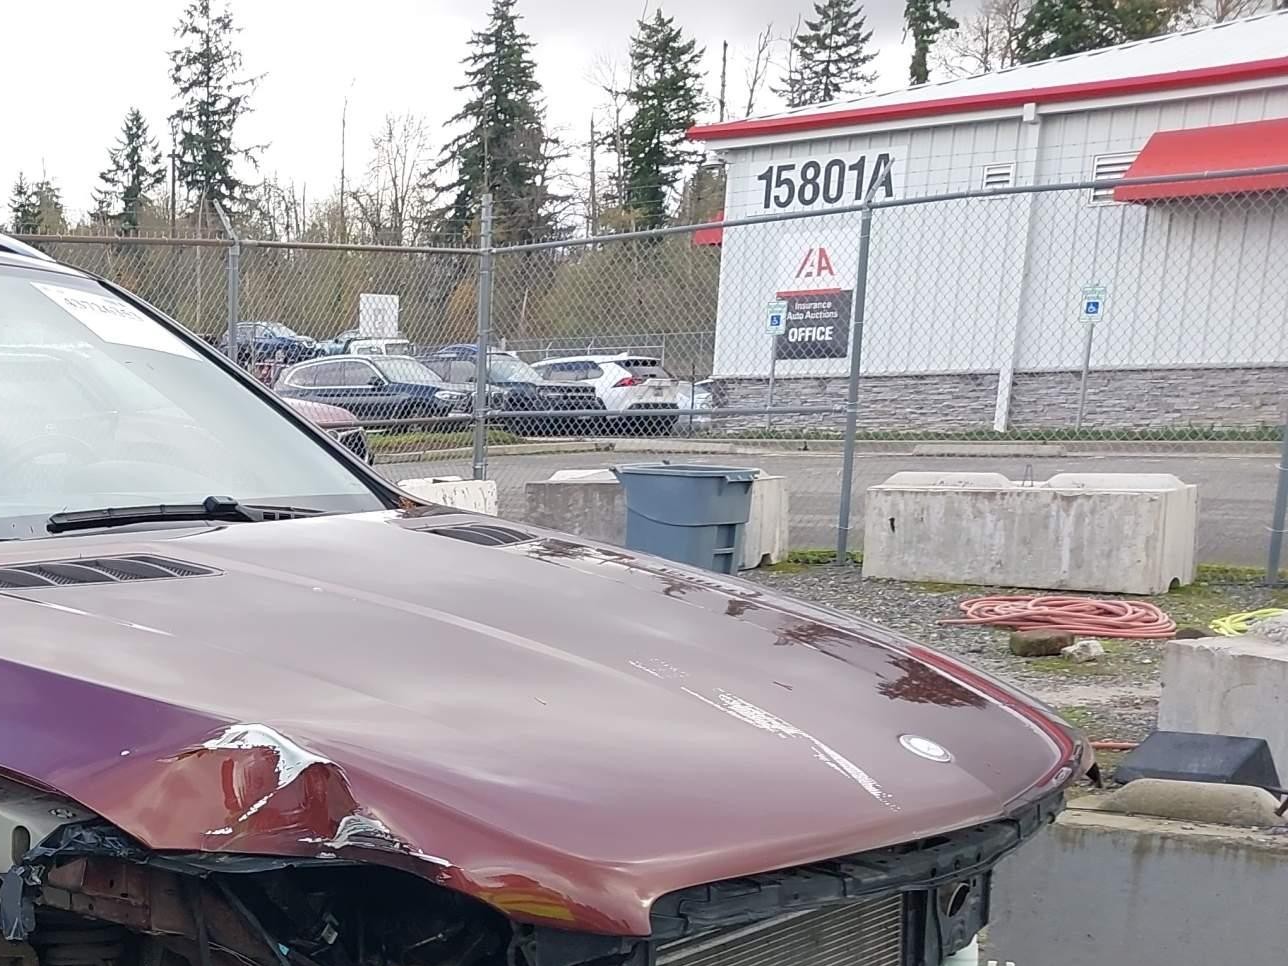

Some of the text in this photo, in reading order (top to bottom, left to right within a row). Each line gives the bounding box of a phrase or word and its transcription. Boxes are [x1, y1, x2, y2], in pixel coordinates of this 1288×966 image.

[757, 153, 894, 209] 15801A
[794, 301, 833, 310] Insurance
[786, 310, 838, 320] Auto Auctions
[788, 326, 834, 342] OFFICE
